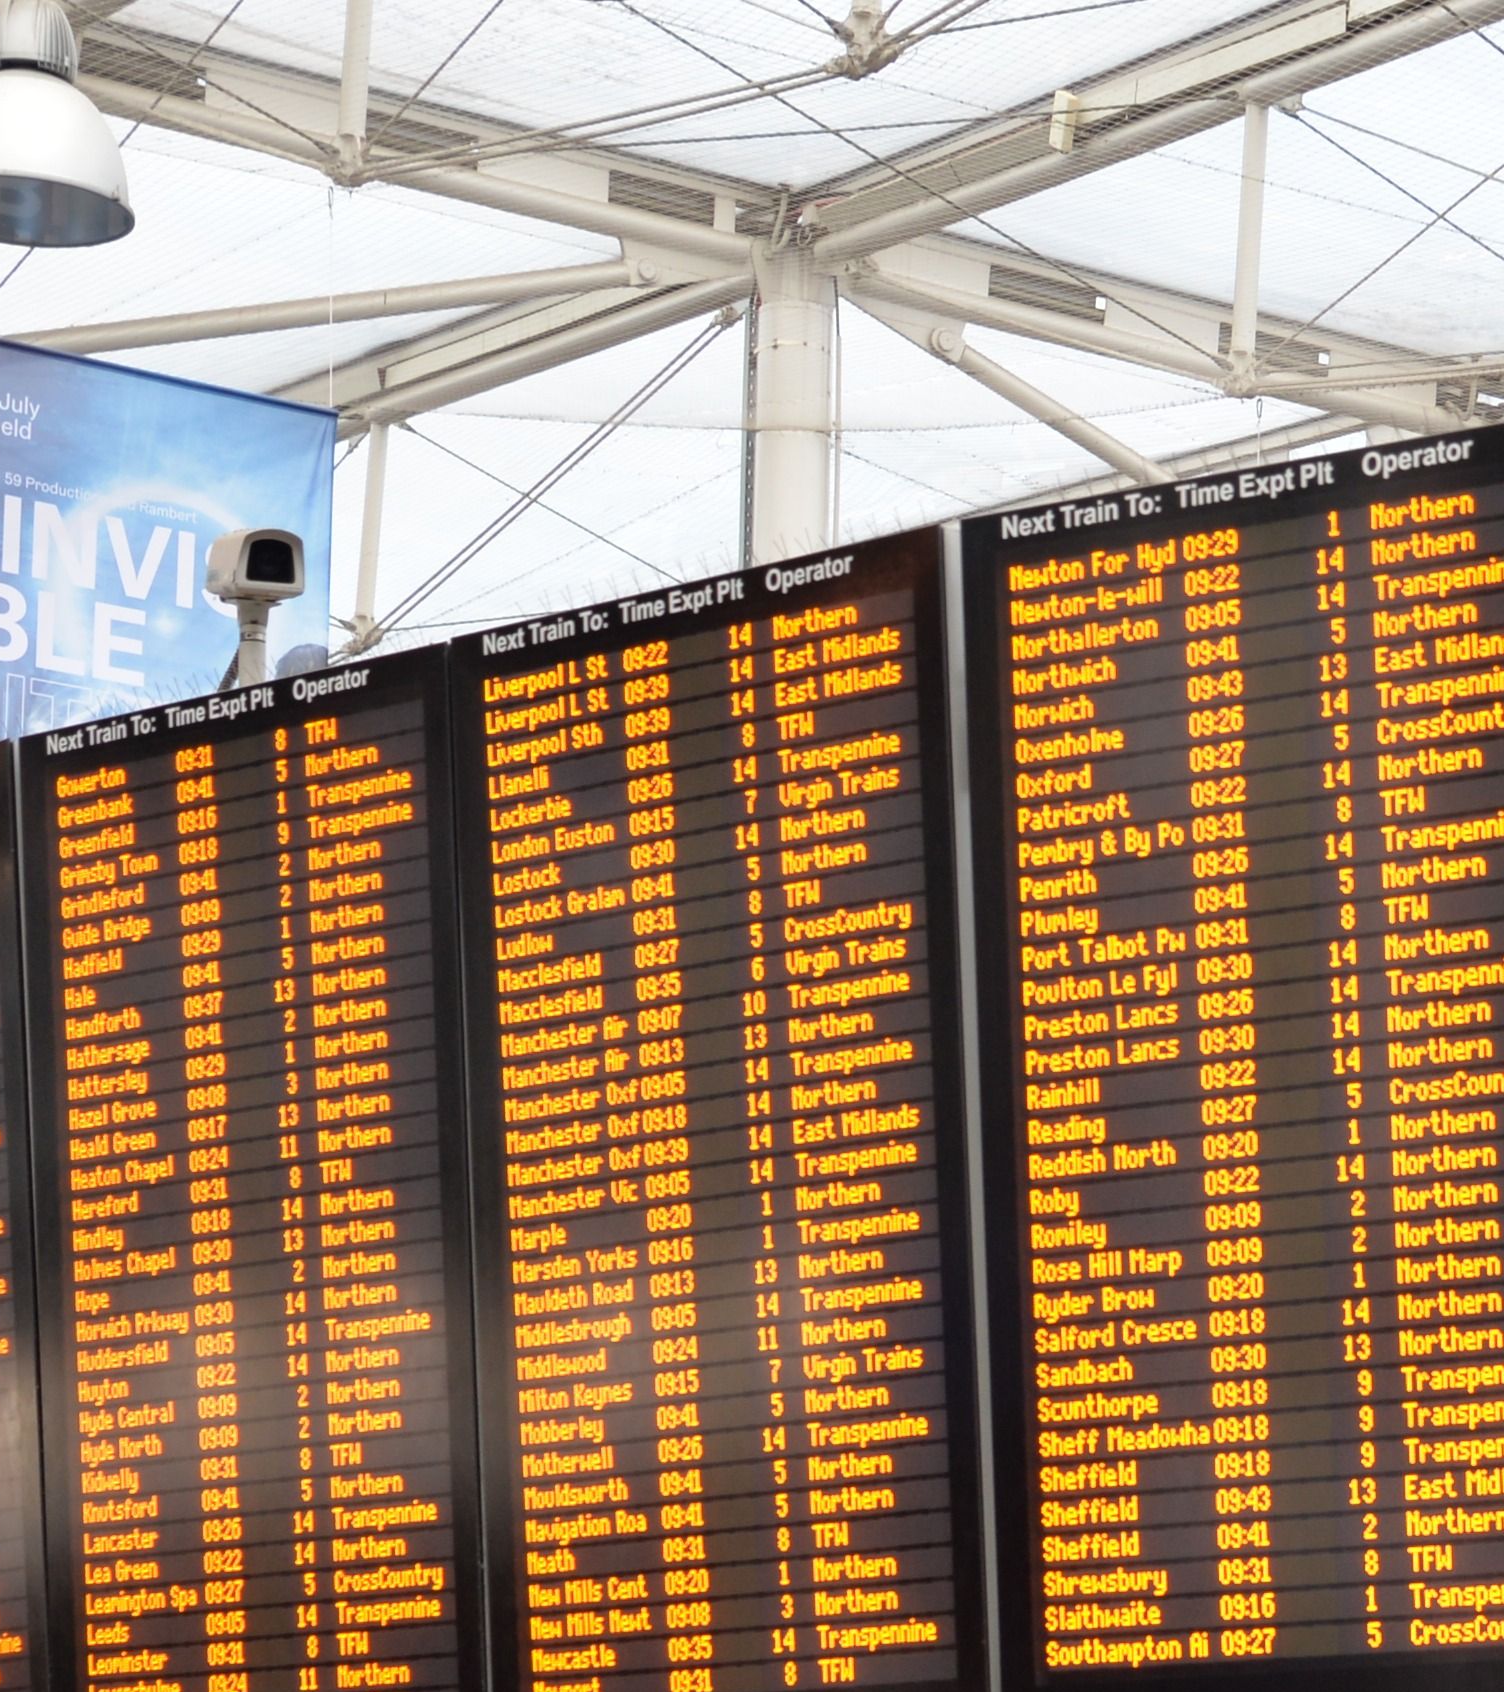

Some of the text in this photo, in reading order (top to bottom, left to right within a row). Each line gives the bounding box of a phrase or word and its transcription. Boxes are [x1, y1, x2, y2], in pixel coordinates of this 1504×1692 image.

[1016, 762, 1094, 800] Oxford
[1188, 739, 1247, 774] 09:27
[1333, 722, 1351, 752] 5
